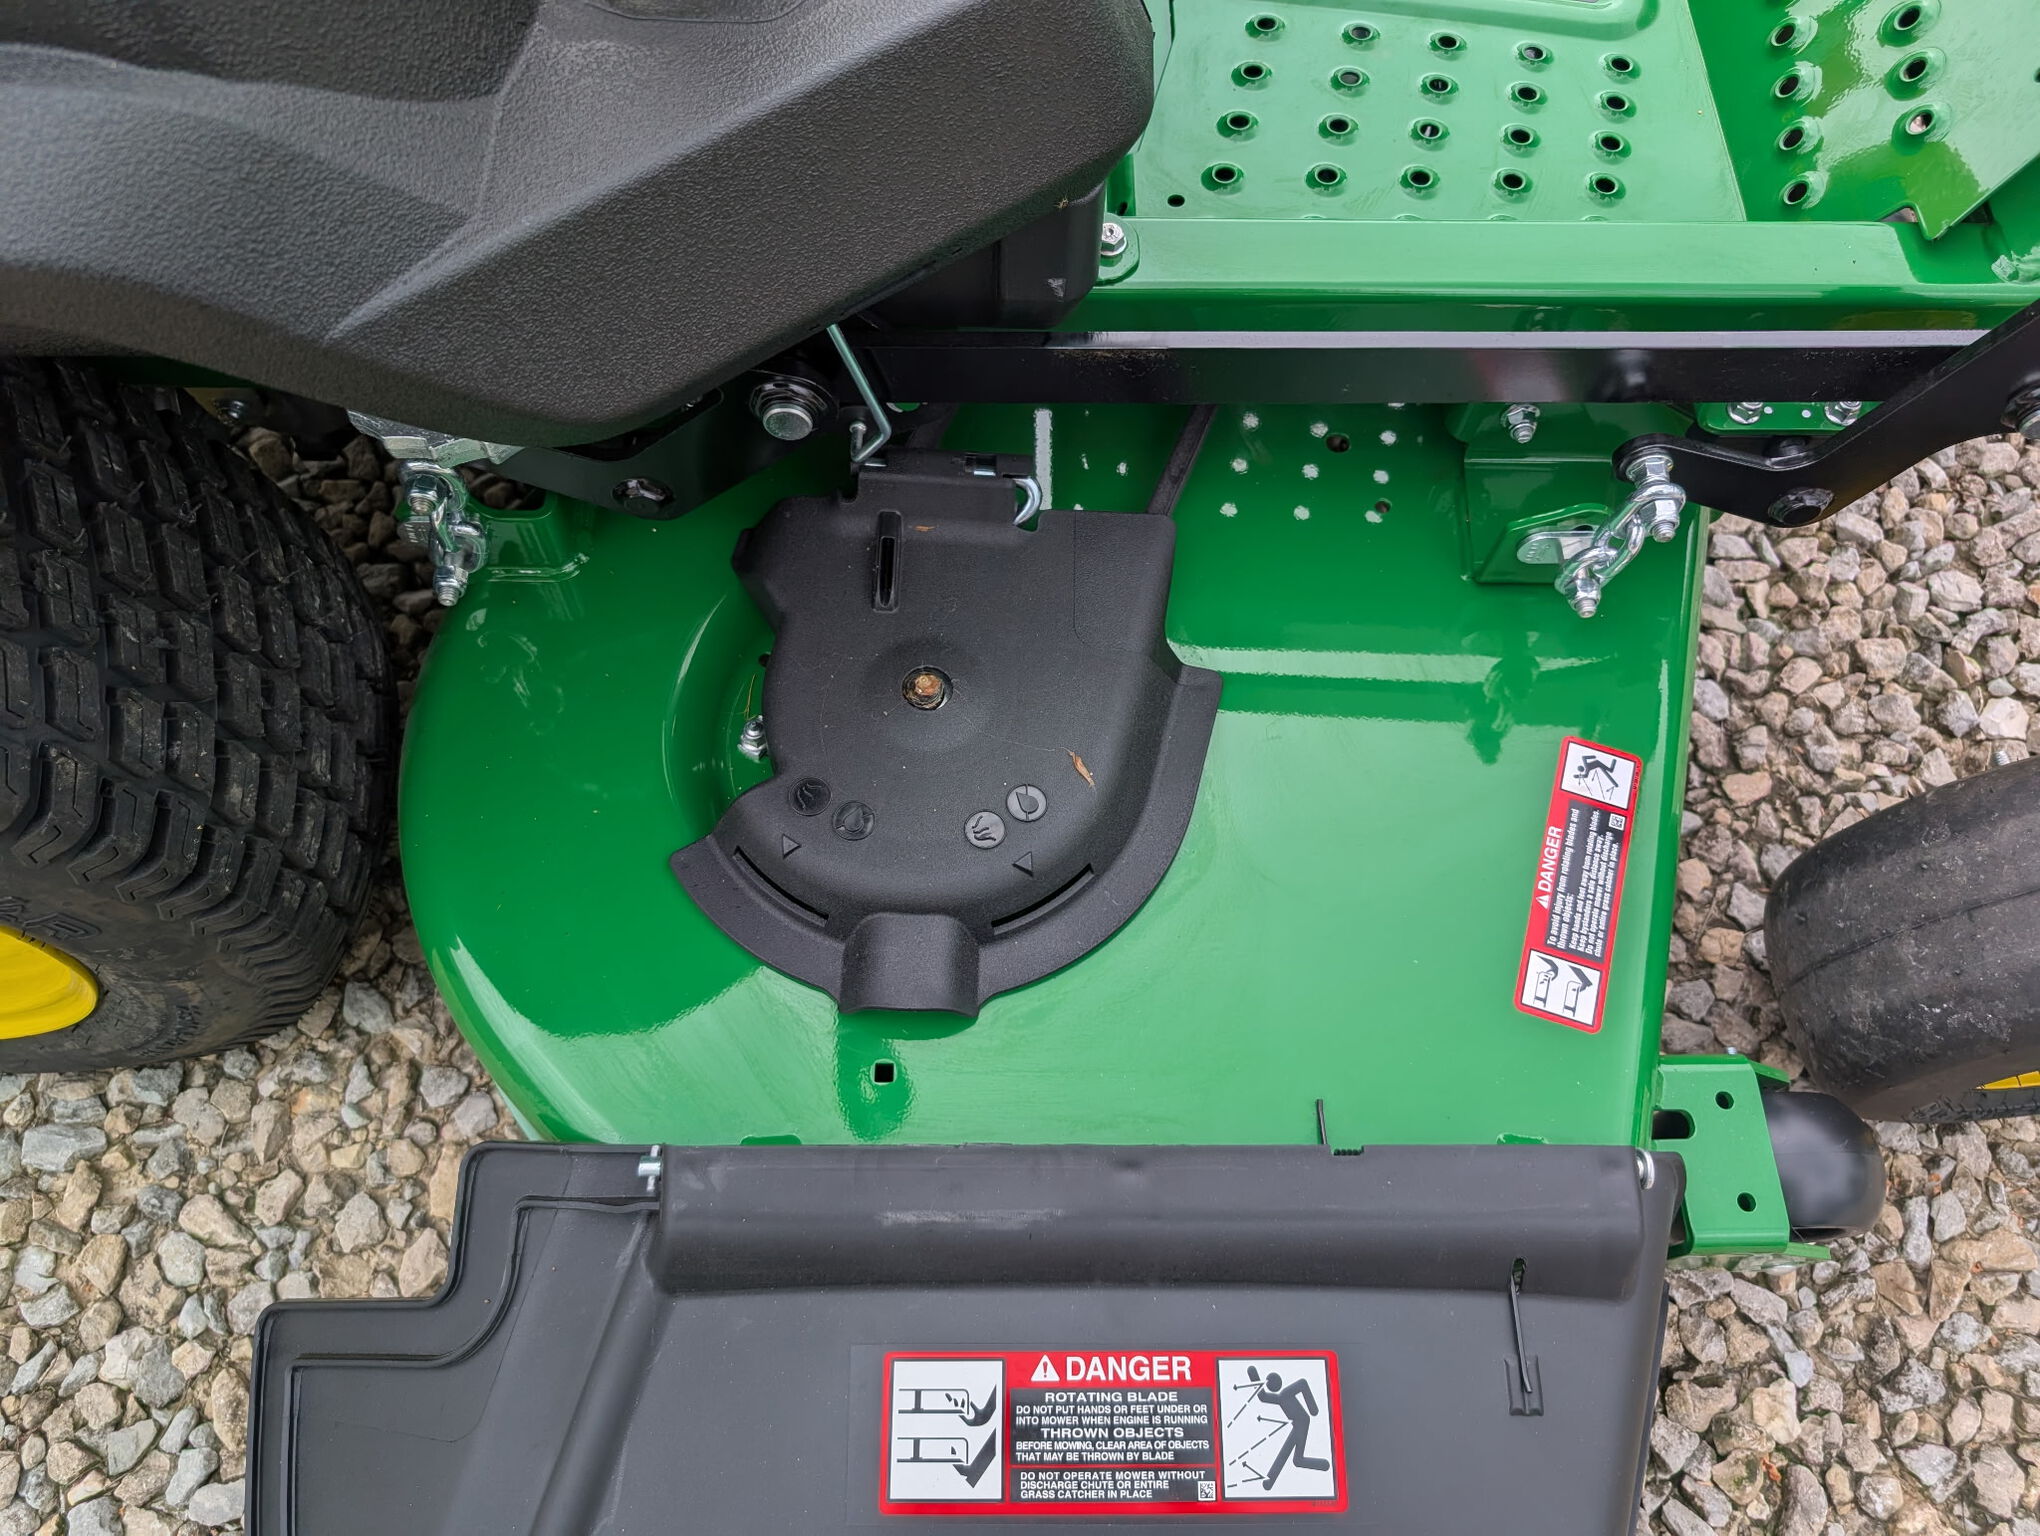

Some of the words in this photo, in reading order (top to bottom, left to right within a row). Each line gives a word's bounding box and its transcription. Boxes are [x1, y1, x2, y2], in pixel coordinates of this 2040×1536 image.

[1570, 808, 1579, 822] and
[1589, 808, 1599, 831] blades.
[1565, 822, 1576, 846] blades
[1585, 830, 1596, 855] rotating
[1594, 833, 1604, 852] away.
[1601, 831, 1613, 861] discharge
[1609, 841, 1619, 861] place.
[1537, 825, 1561, 893] DANGER
[1560, 846, 1573, 875] rotating
[1583, 854, 1591, 870] from
[1589, 852, 1600, 879] distance
[1580, 870, 1589, 887] away
[1597, 861, 1607, 885] without
[1604, 868, 1614, 892] catcher
[1557, 874, 1566, 892] from
[1587, 879, 1595, 893] safe
[1577, 887, 1586, 899] feet
[1594, 885, 1603, 907] mower
[1602, 892, 1611, 910] grass
[1553, 892, 1565, 914] injury
[1562, 892, 1575, 922] objects:
[1575, 899, 1584, 912] and
[1549, 914, 1560, 935] avoid
[1572, 912, 1581, 932] hands
[1580, 899, 1592, 934] bystanders
[1589, 907, 1601, 932] operate
[1598, 910, 1607, 930] entire
[1547, 935, 1556, 946] To
[1557, 921, 1569, 949] thrown
[1569, 932, 1579, 949] Keep
[1577, 934, 1587, 951] Keep
[1587, 932, 1595, 943] not
[1597, 930, 1604, 938] or
[1585, 944, 1593, 954] Do
[1593, 938, 1603, 957] chute
[1067, 1356, 1191, 1380] DANGER
[1046, 1392, 1122, 1402] ROTATING
[1128, 1392, 1177, 1401] BLADE
[1016, 1406, 1030, 1414] DO
[1034, 1406, 1053, 1414] NOT
[1056, 1406, 1074, 1414] PUT
[1078, 1406, 1111, 1414] HANDS
[1114, 1405, 1127, 1413] OR
[1131, 1405, 1154, 1413] FEET
[1158, 1405, 1190, 1413] UNDER
[1193, 1405, 1207, 1413] OR
[1016, 1416, 1039, 1424] INTO
[1042, 1416, 1078, 1424] MOWER
[1082, 1416, 1110, 1424] WHEN
[1114, 1416, 1149, 1424] ENGINE
[1152, 1416, 1161, 1424] IS
[1164, 1416, 1207, 1424] RUNNING
[1041, 1428, 1108, 1438] THROWN
[1114, 1428, 1184, 1438] OBJECTS
[1016, 1442, 1052, 1450] BEFORE
[1054, 1442, 1094, 1450] MOWING,
[1096, 1441, 1126, 1450] CLEAR
[1128, 1441, 1152, 1449] AREA
[1154, 1441, 1166, 1449] OF
[1168, 1440, 1209, 1449] OBJECTS
[1016, 1452, 1041, 1460] THAT
[1044, 1452, 1063, 1460] MAY
[1066, 1452, 1079, 1460] BE
[1082, 1452, 1124, 1460] THROWN
[1127, 1452, 1139, 1460] BY
[1142, 1452, 1174, 1460] BLADE
[1021, 1472, 1035, 1480] DO
[1039, 1472, 1060, 1480] NOT
[1064, 1472, 1112, 1480] OPERATE
[1116, 1472, 1155, 1480] MOWER
[1157, 1471, 1205, 1479] WITHOUT
[1021, 1481, 1078, 1489] DISCHARGE
[1079, 1481, 1114, 1489] CHUTE
[1115, 1480, 1131, 1489] OR
[1134, 1480, 1169, 1489] ENTIRE
[1021, 1490, 1055, 1498] GRASS
[1058, 1490, 1104, 1498] CATCHER
[1108, 1490, 1117, 1498] IN
[1120, 1490, 1152, 1498] PLACE
